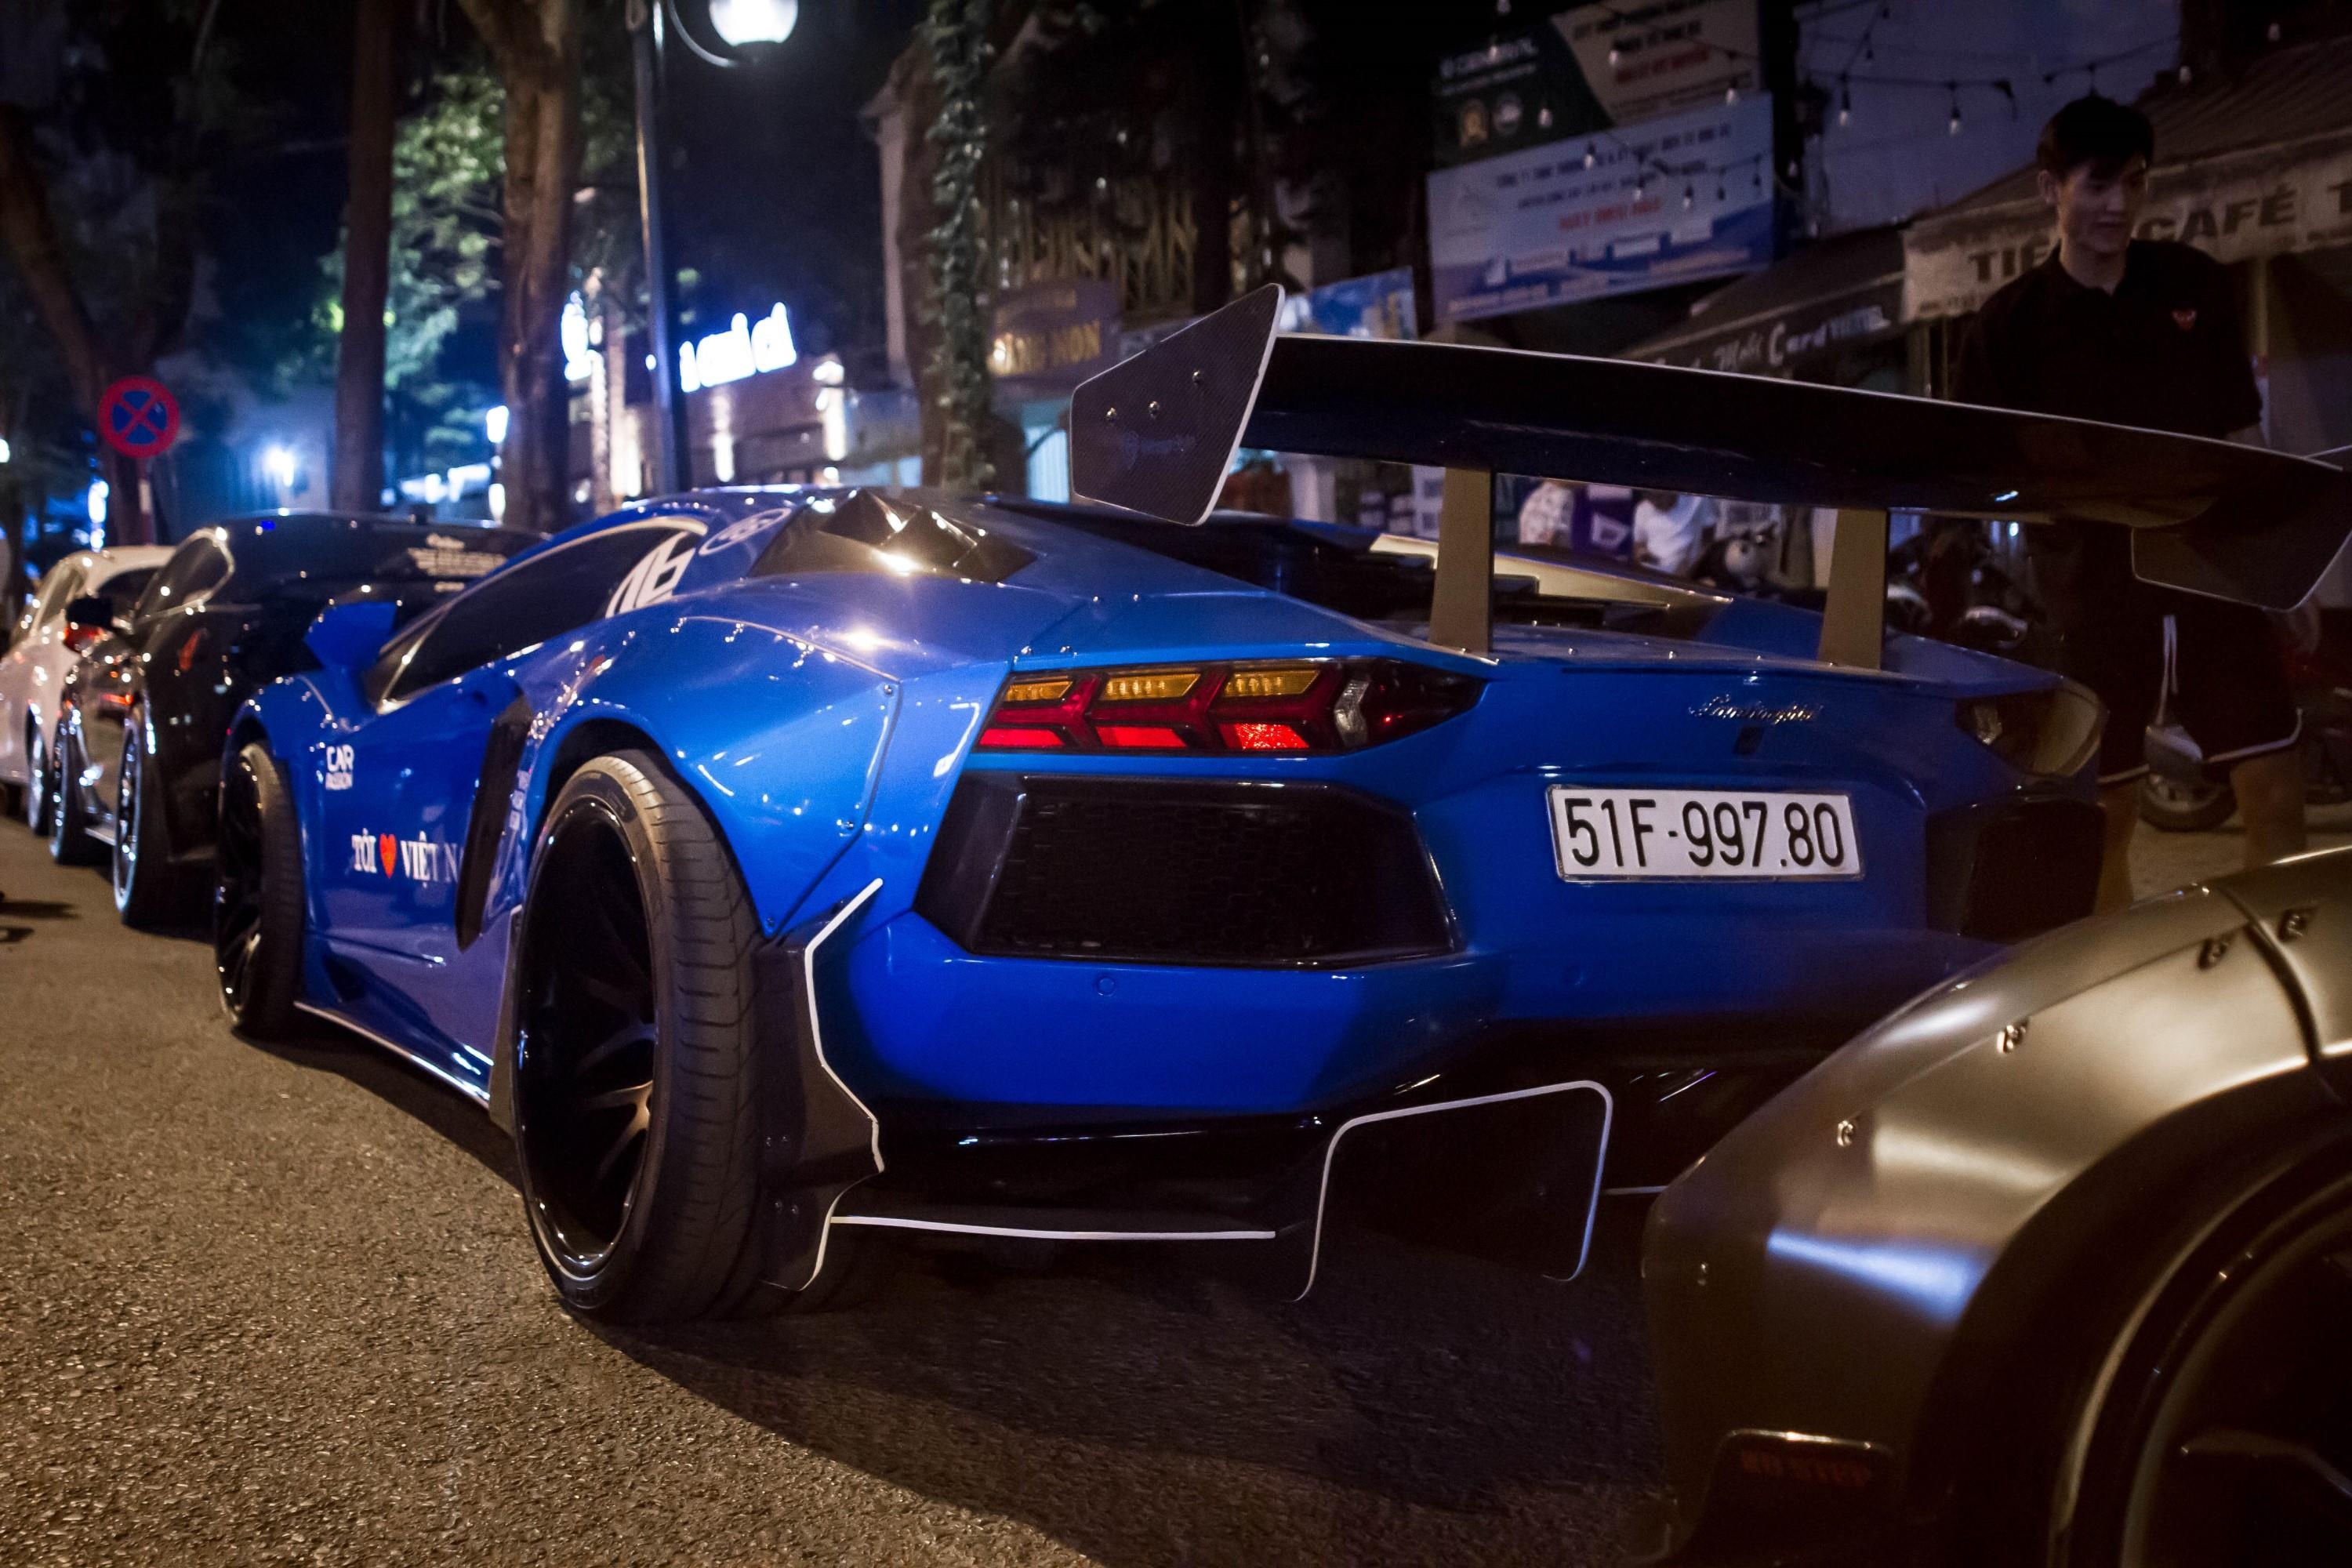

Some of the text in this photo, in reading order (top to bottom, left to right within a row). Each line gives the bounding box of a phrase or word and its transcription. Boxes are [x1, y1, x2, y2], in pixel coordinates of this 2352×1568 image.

[326, 744, 354, 771] CAR
[351, 827, 377, 873] TÔI
[400, 830, 438, 888] VIỆT
[1564, 797, 1845, 868] 51F-997.80
